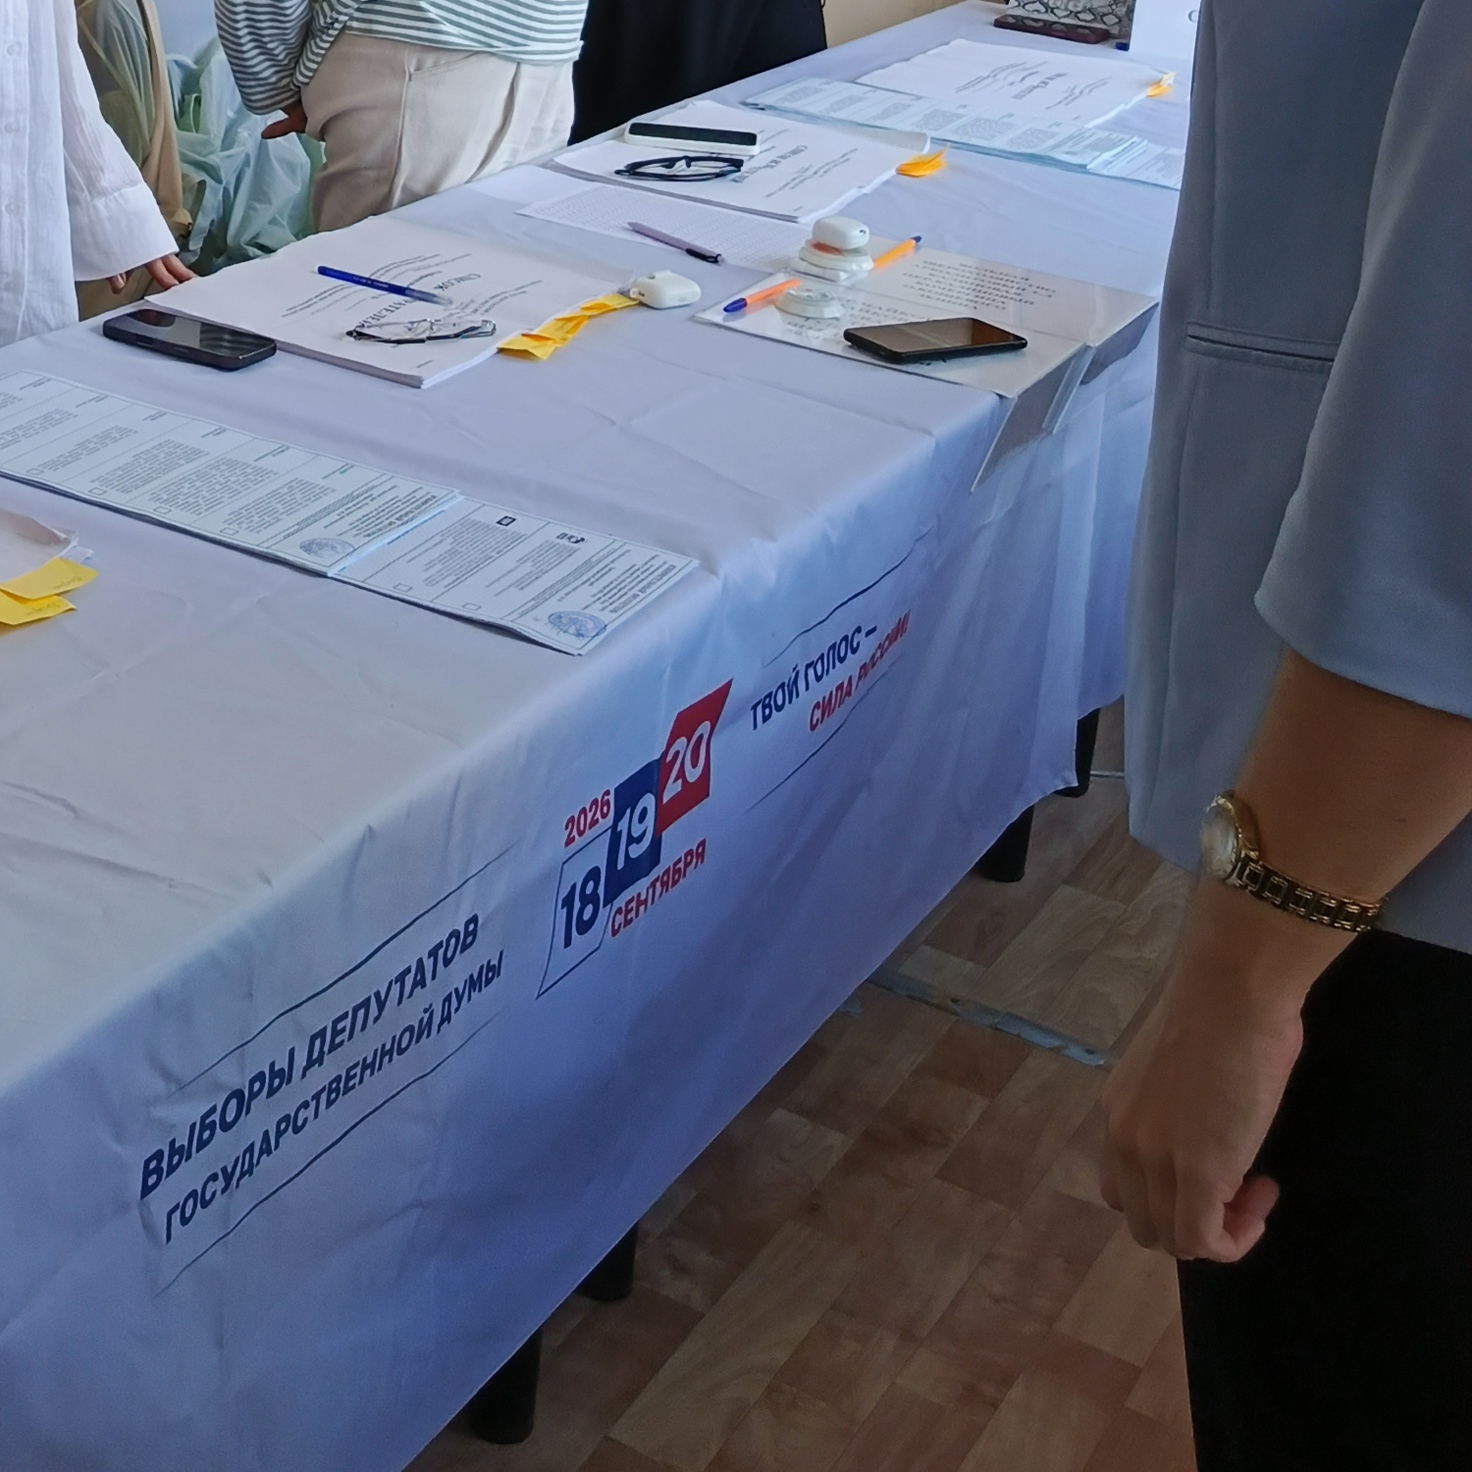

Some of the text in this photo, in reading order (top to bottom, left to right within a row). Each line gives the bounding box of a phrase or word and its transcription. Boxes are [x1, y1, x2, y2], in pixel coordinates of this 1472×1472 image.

[750, 664, 800, 731] ТВОЙ
[804, 625, 862, 692] ГОЛОС
[809, 674, 853, 732] СИЛА
[561, 720, 711, 949] 18 19 20
[564, 788, 611, 848] 2026
[610, 838, 706, 938] СЕНТЯБРЯ
[140, 913, 479, 1200] ВЫБОРЫ ДЕПУТАТОВ
[165, 949, 504, 1245] ГОСУДАРСТВЕННОЙ ДУМЫ
